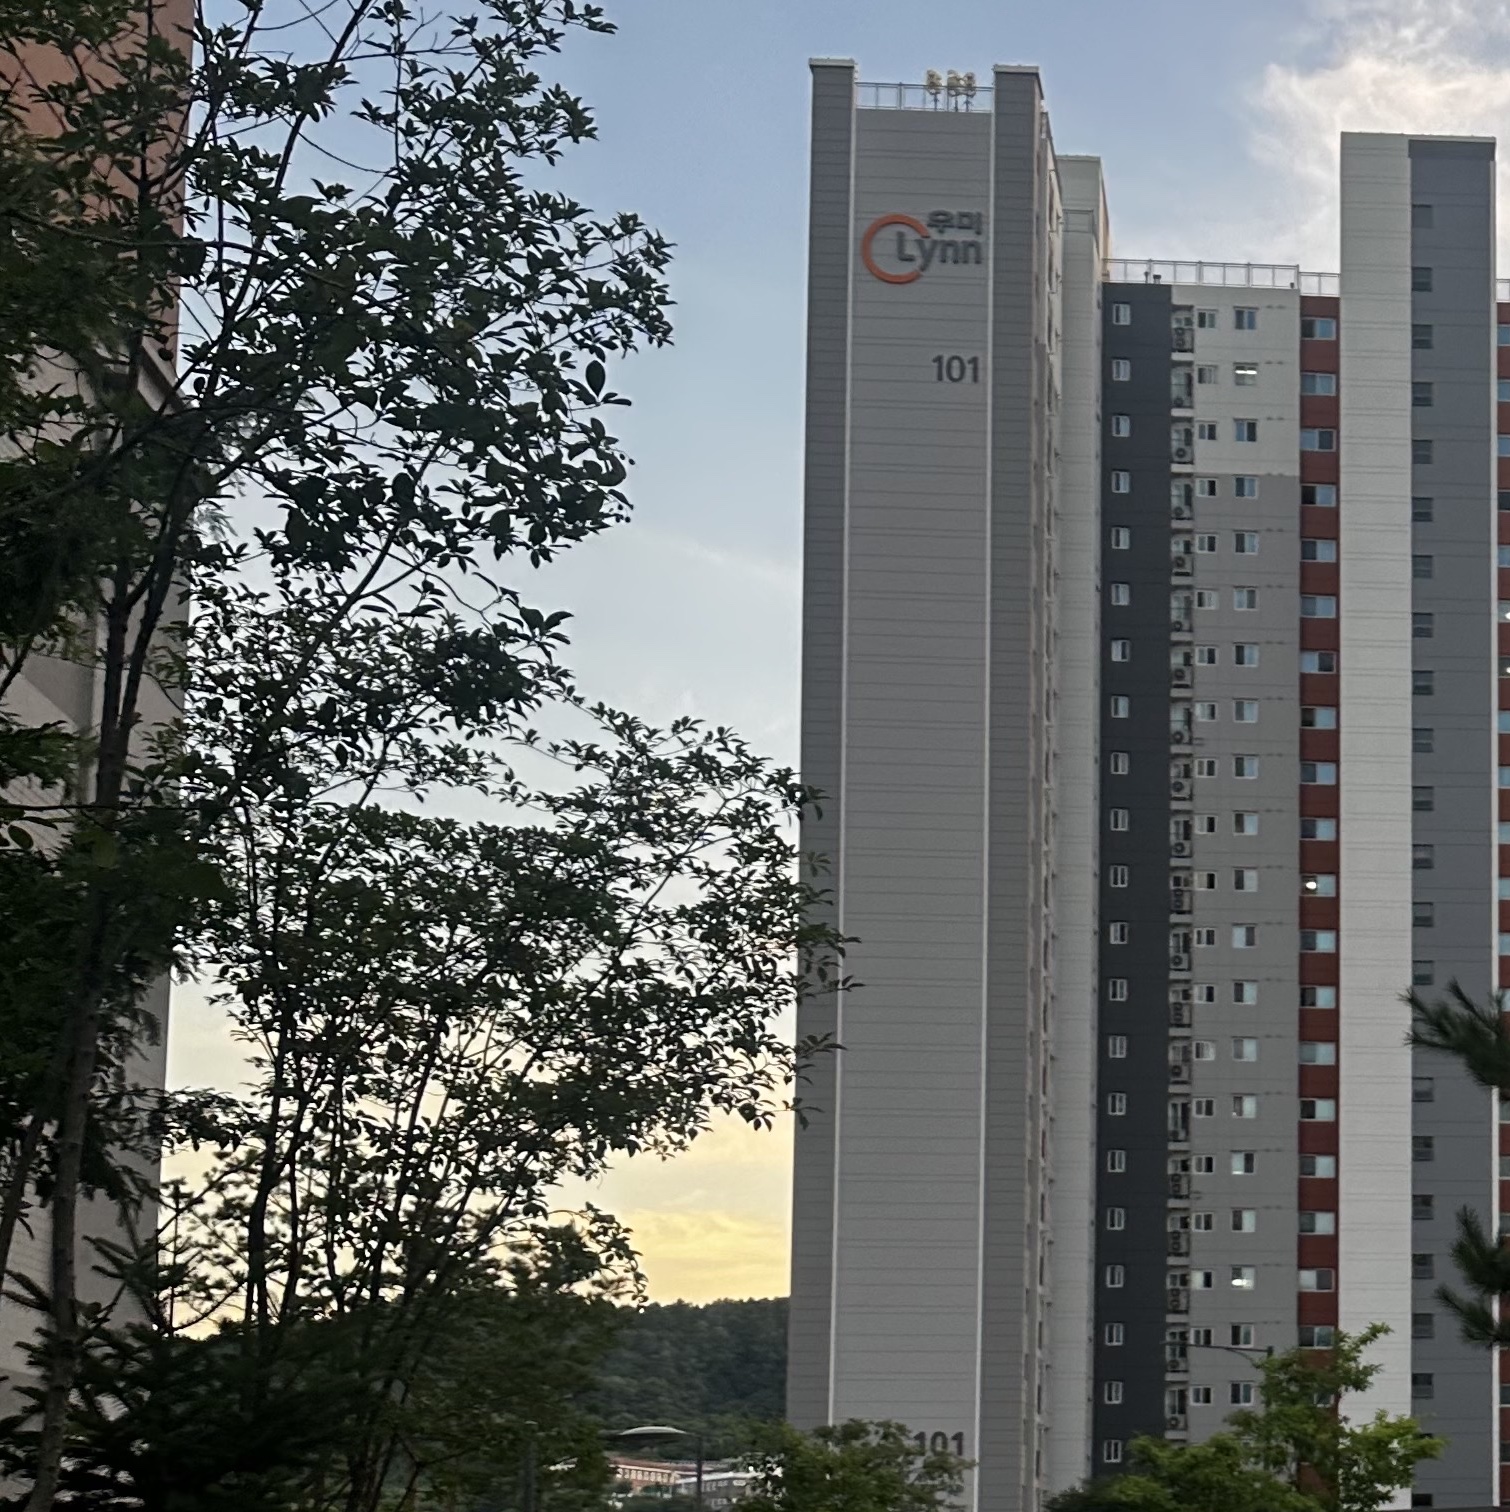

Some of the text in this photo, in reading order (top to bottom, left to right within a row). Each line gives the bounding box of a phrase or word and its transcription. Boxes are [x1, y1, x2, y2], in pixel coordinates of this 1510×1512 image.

[926, 210, 983, 236] 우미
[896, 231, 983, 272] Lynn
[931, 355, 980, 383] 101
[913, 1431, 964, 1456] 101
